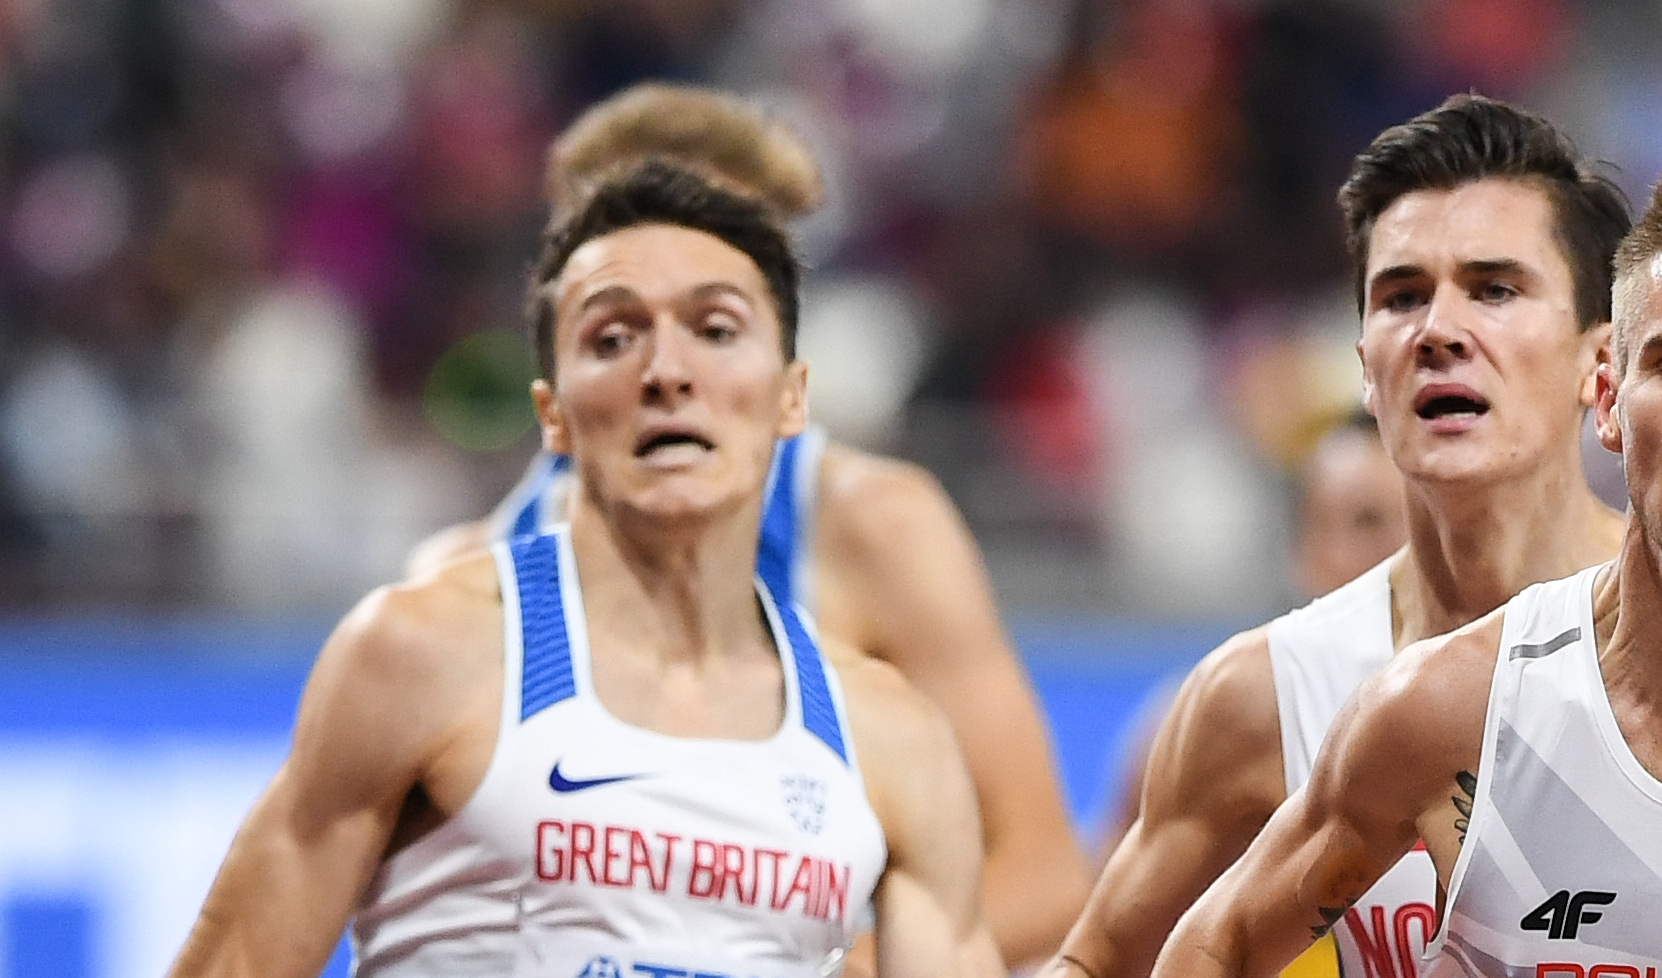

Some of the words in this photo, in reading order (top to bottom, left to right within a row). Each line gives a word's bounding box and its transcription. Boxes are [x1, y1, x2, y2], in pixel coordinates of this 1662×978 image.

[535, 819, 682, 894] GREAT
[687, 838, 851, 926] BRITAIN
[1520, 889, 1618, 940] 4F
